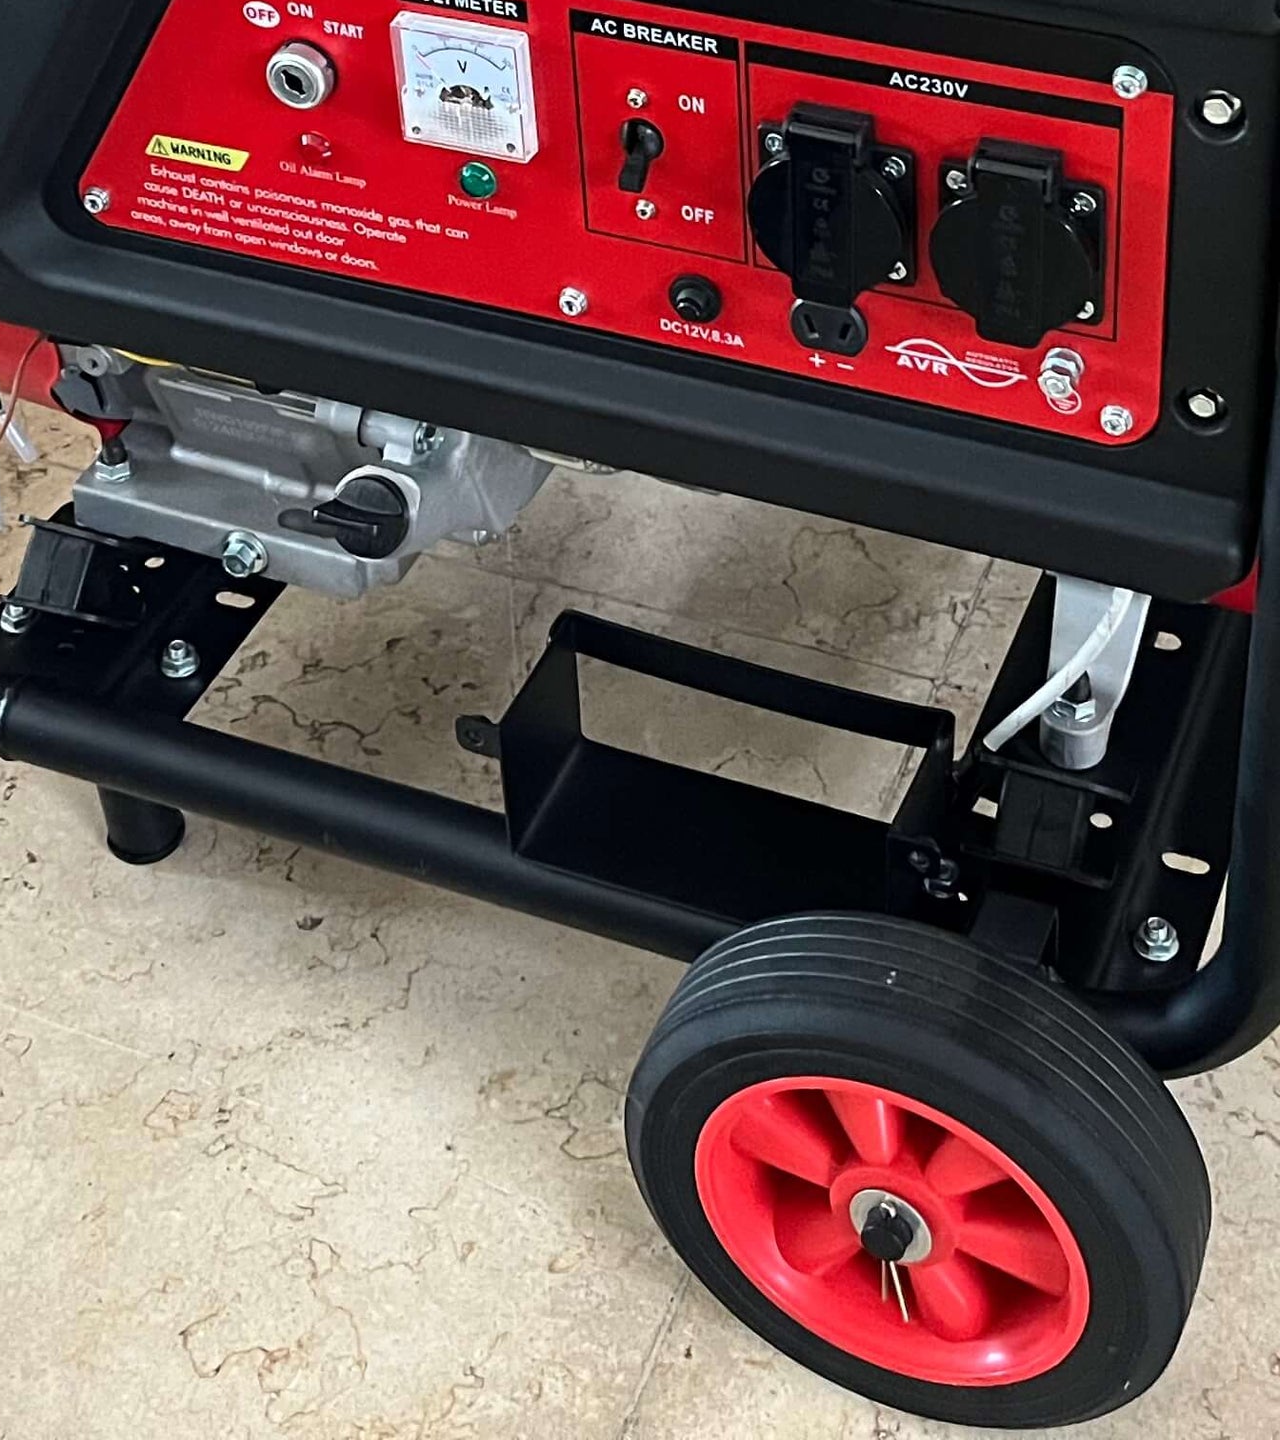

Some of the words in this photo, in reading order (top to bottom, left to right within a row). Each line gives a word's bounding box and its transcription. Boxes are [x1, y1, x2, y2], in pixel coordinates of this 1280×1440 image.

[247, 5, 276, 23] OFF
[287, 2, 313, 19] ON
[323, 20, 365, 40] START
[590, 17, 618, 36] AC
[623, 24, 719, 54] BREAKER
[457, 59, 468, 74] V
[888, 71, 969, 99] AC230V
[678, 94, 705, 114] ON
[170, 142, 231, 166] WARNING
[279, 159, 297, 174] Oil
[300, 166, 334, 182] Alarm
[335, 172, 367, 190] Lamp
[144, 181, 179, 197] cause
[182, 186, 225, 206] DEATH
[229, 198, 243, 209] or
[353, 221, 407, 244] Operate
[150, 163, 196, 184] Exhaust
[200, 176, 250, 195] contains
[254, 188, 318, 209] poisonous
[320, 200, 384, 223] monoxide
[415, 217, 442, 235] that
[445, 227, 469, 240] can
[447, 193, 483, 211] Power
[485, 201, 518, 221] Lamp
[137, 196, 188, 215] machine
[190, 204, 203, 217] in
[204, 210, 230, 223] well
[231, 215, 290, 236] ventilated
[292, 227, 313, 240] out
[316, 230, 345, 247] door
[681, 205, 715, 225] OFF
[169, 218, 202, 235] away
[203, 221, 233, 239] from
[235, 232, 267, 247] open
[268, 238, 323, 259] windows
[325, 250, 338, 261] or
[896, 354, 950, 377] AVR
